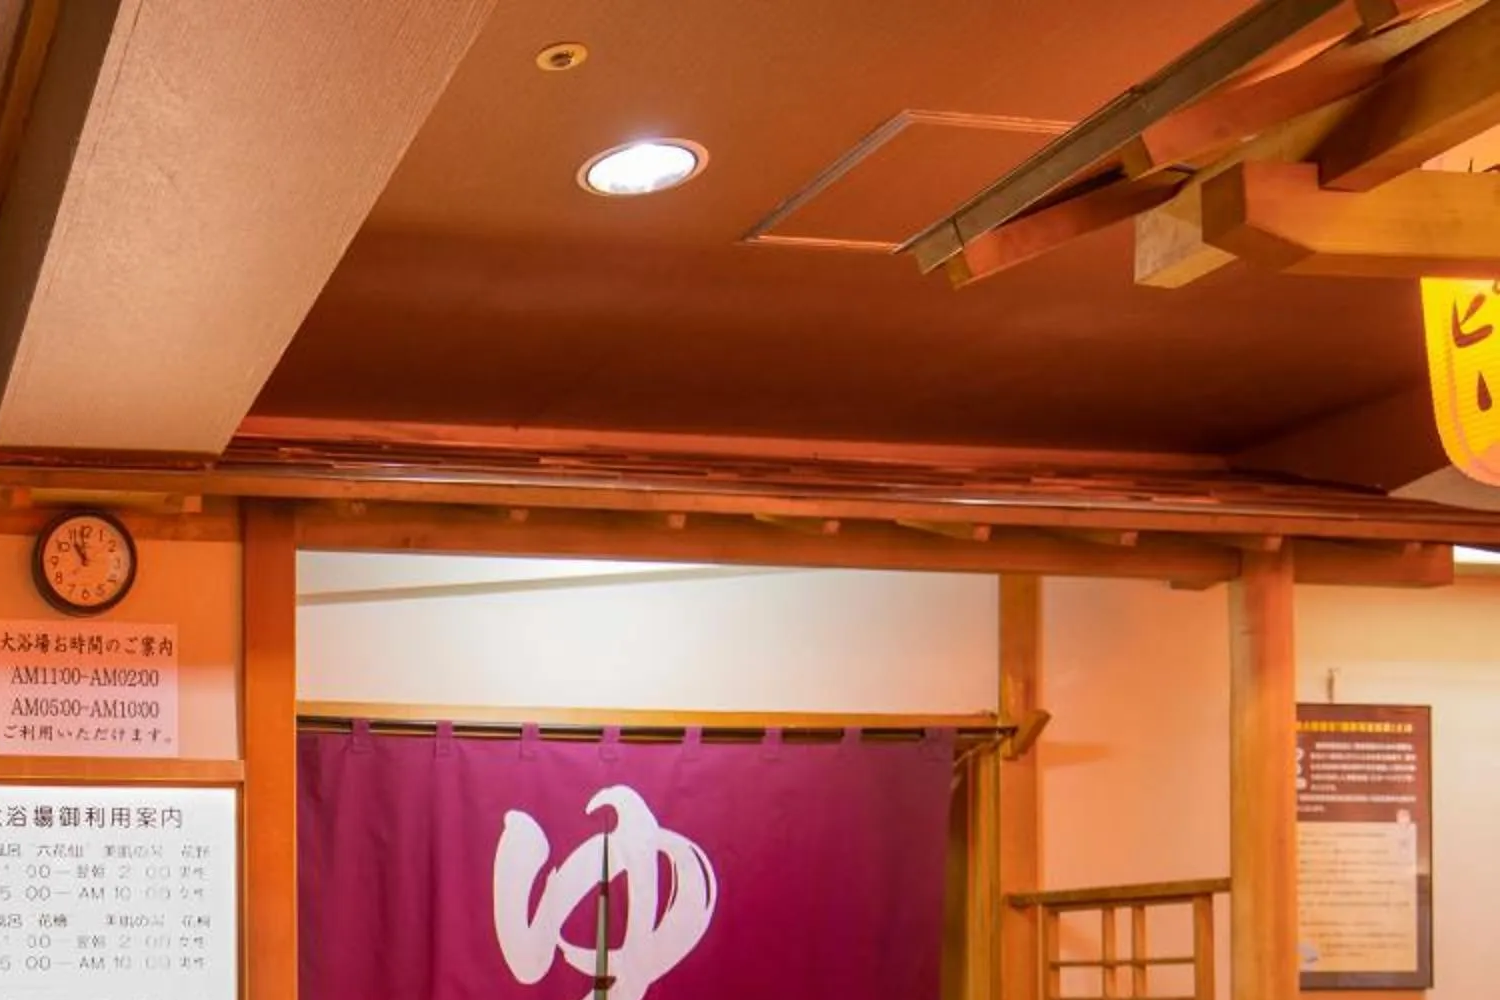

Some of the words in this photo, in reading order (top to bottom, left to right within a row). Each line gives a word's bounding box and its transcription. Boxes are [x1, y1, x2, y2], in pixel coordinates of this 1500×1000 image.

[1, 632, 173, 656] 大浴場お時間のご案内
[3, 725, 173, 743] ご利用いただけます。
